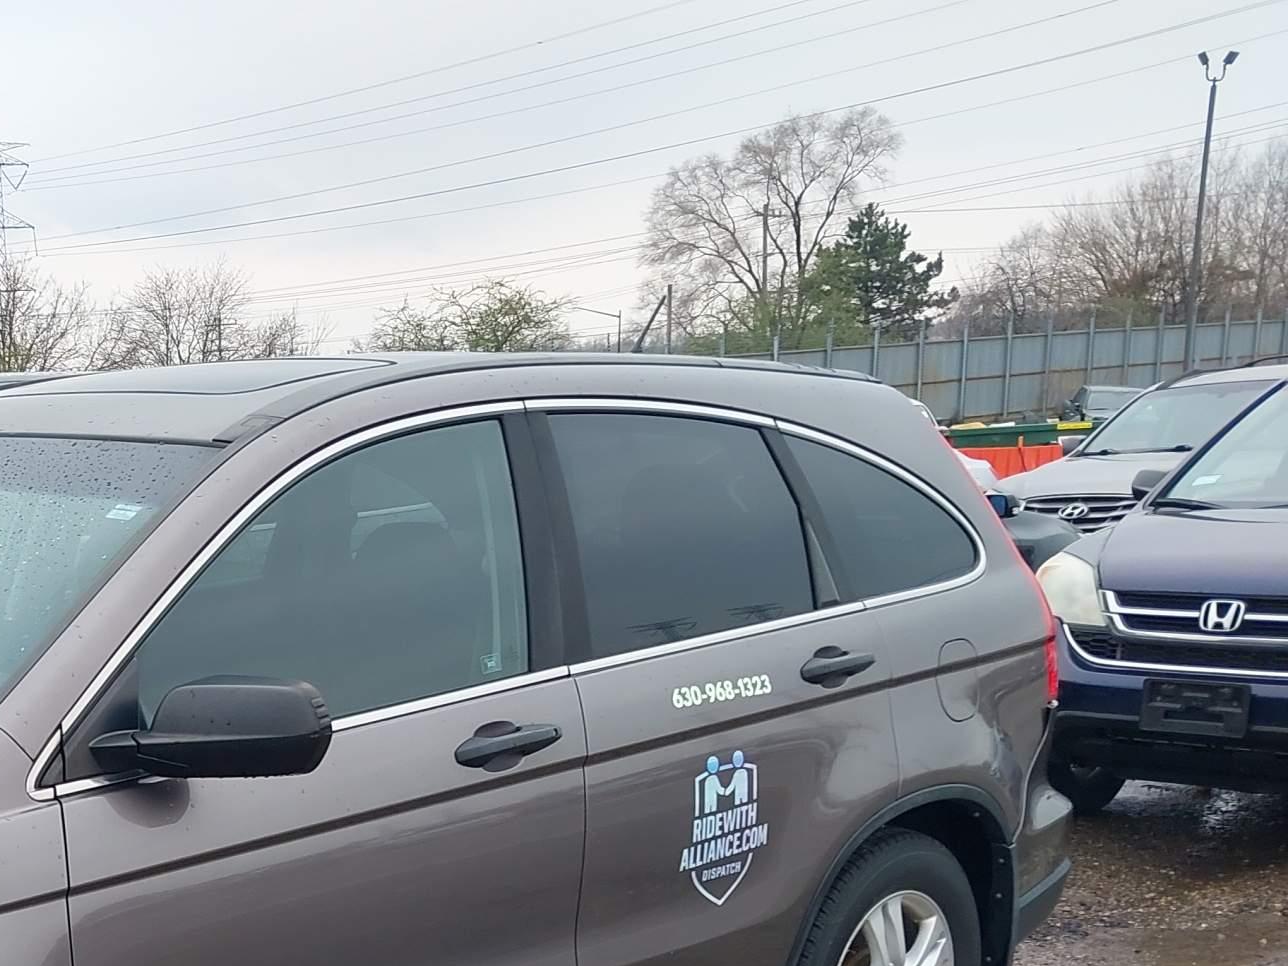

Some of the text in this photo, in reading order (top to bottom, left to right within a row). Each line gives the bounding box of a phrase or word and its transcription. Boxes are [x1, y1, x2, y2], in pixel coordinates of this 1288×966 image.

[673, 675, 772, 708] 630-968-1323
[693, 803, 757, 843] RIDEWITH
[679, 823, 768, 872] ALLIANCE.COM
[702, 861, 742, 882] DISPATCH
